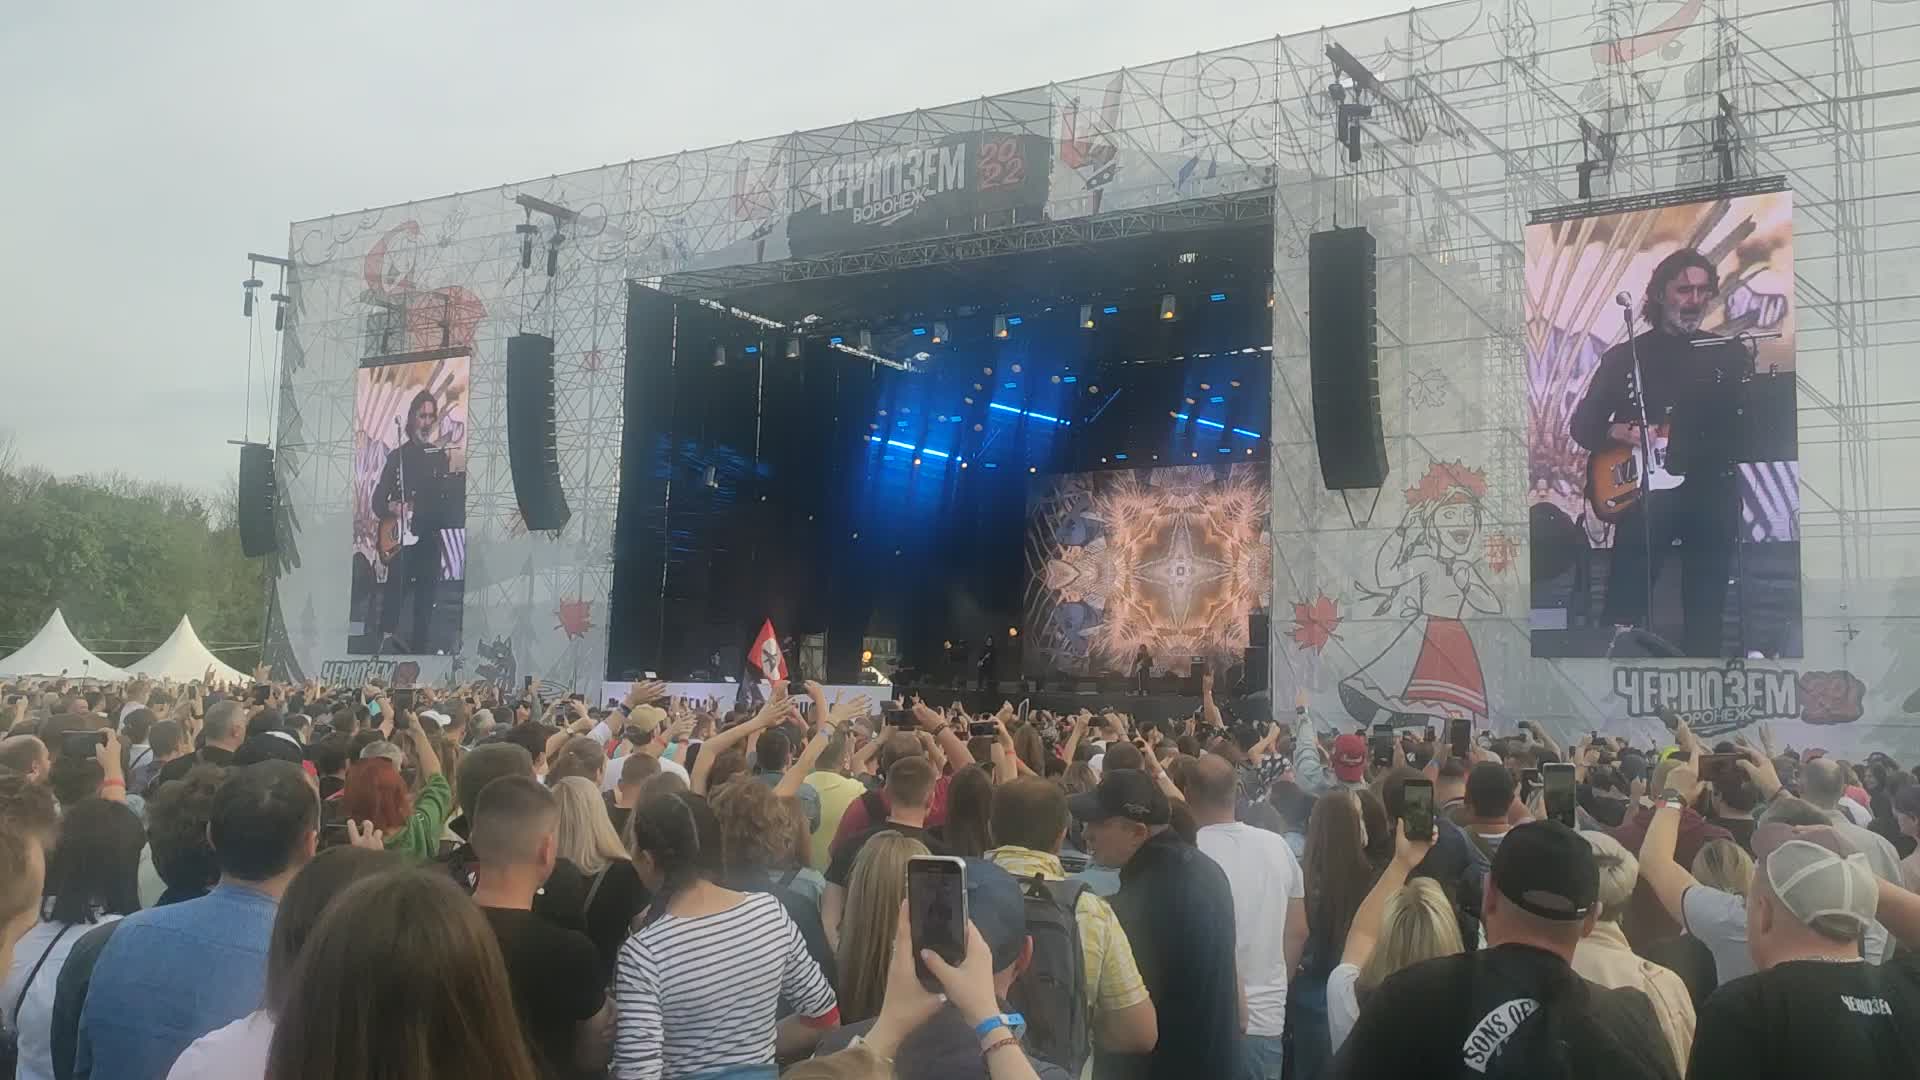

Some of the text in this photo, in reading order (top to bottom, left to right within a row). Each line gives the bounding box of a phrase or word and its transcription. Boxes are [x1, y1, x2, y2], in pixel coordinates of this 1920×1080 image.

[808, 143, 967, 214] ЧЕРНОЗЕМ
[853, 187, 935, 223] ВОРОНЕЖ
[1616, 669, 1797, 715] ЧЕРНОЗЕМ
[1677, 704, 1763, 725] ОРОНЕЖ
[1463, 1001, 1532, 1064] SONS OF
